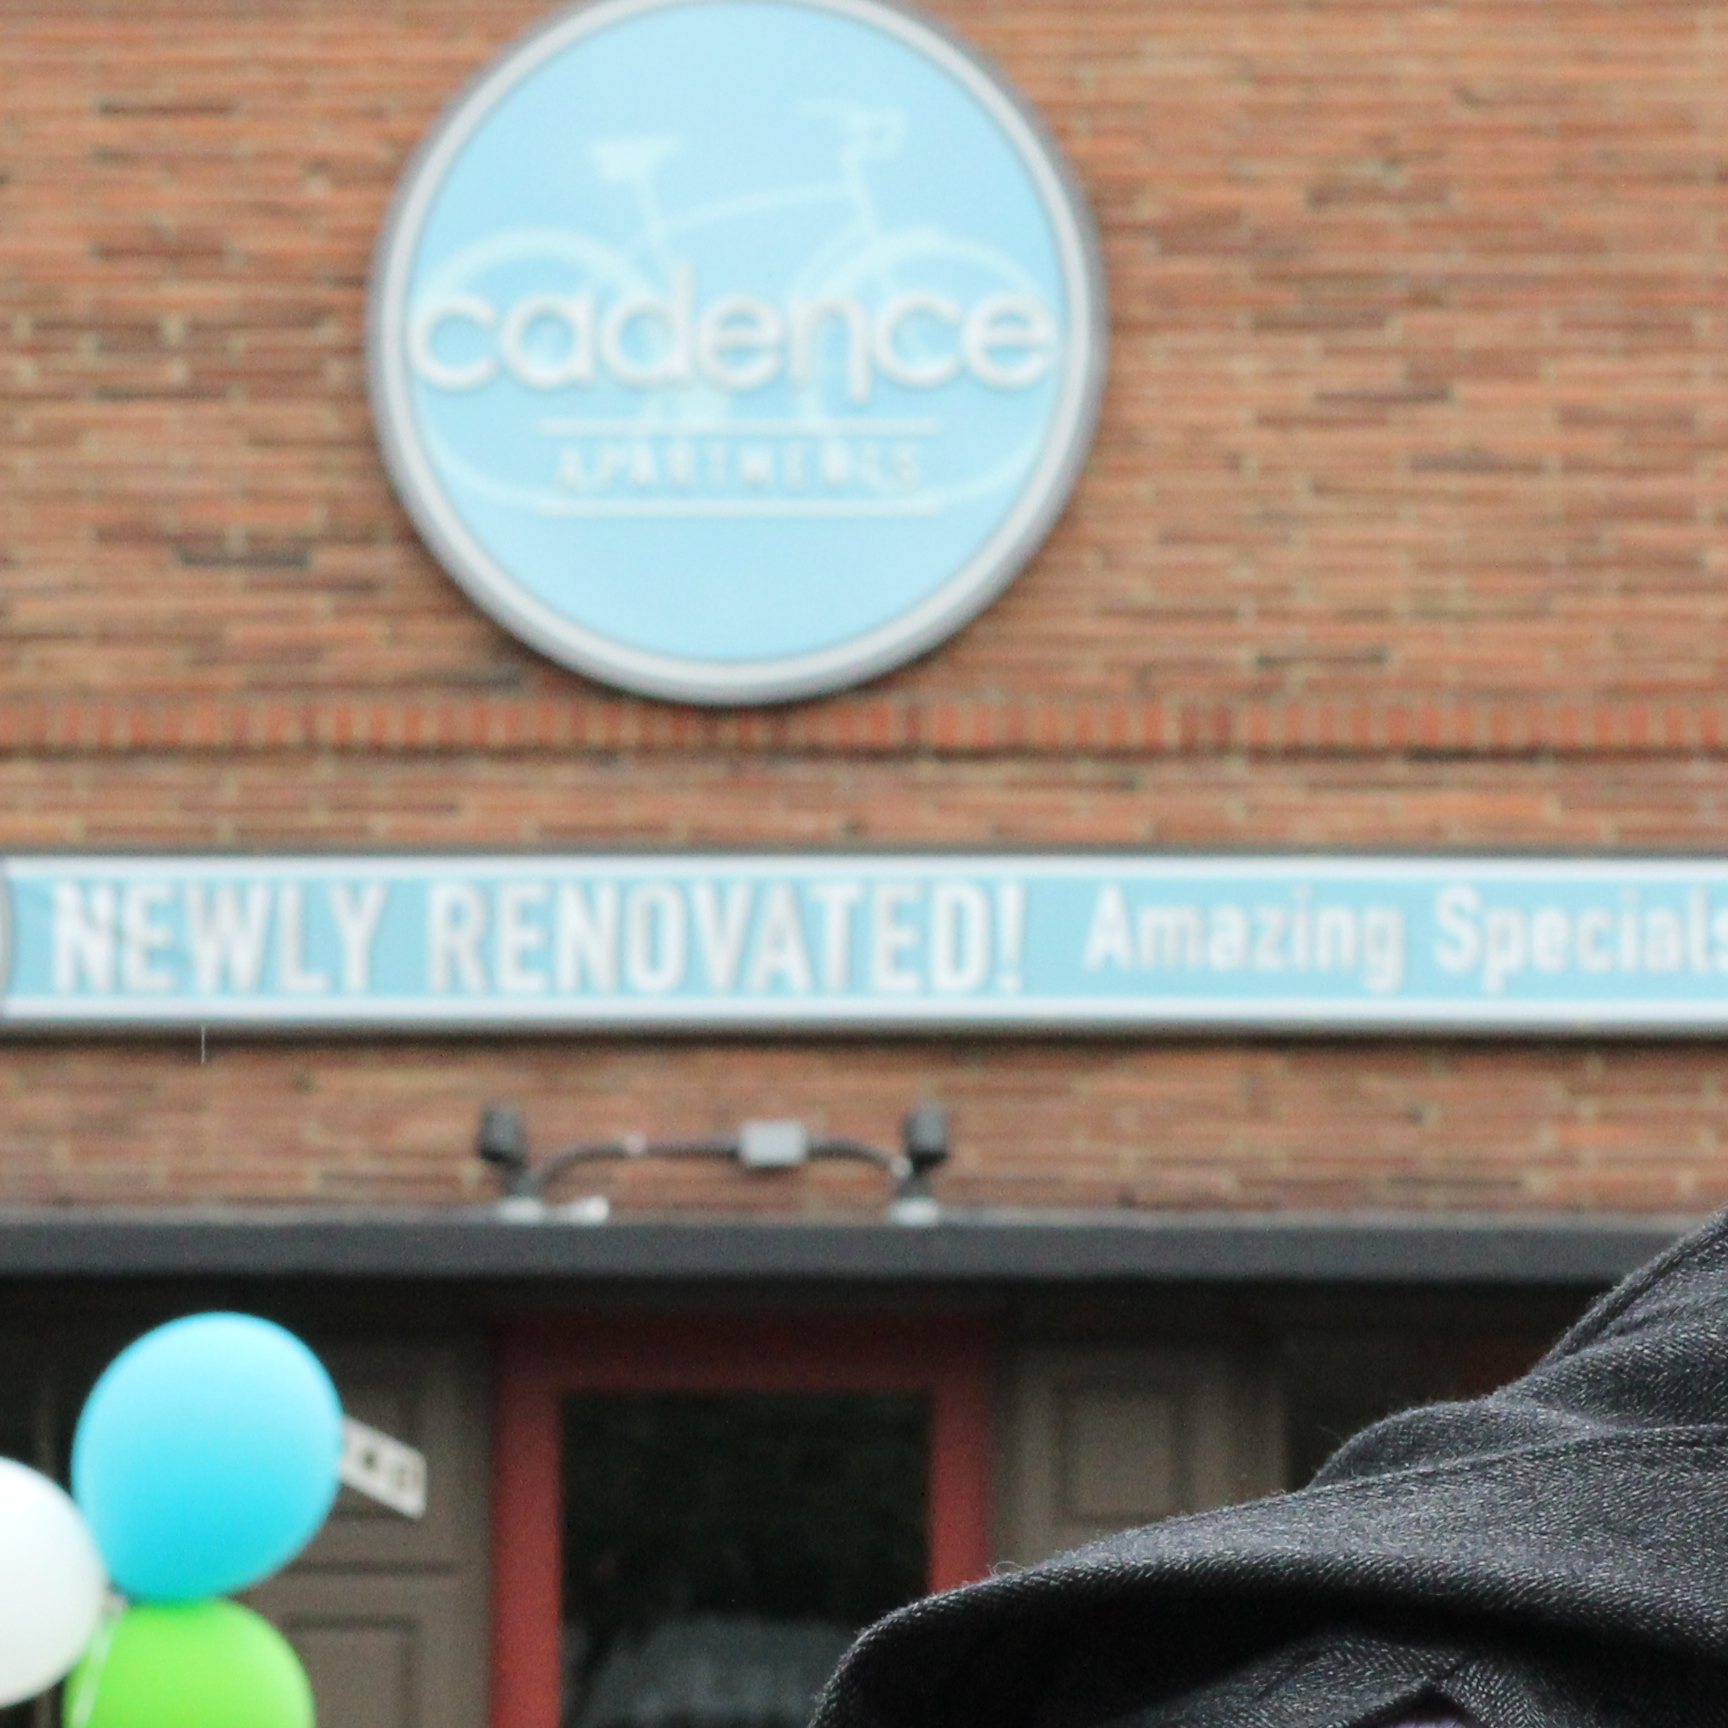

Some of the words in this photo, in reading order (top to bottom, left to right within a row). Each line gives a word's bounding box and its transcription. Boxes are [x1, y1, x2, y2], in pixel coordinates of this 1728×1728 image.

[408, 256, 1060, 402] cadence
[53, 880, 386, 995] NEWLY
[426, 879, 1027, 995] RENOVATED!
[1084, 881, 1408, 994] Amazing
